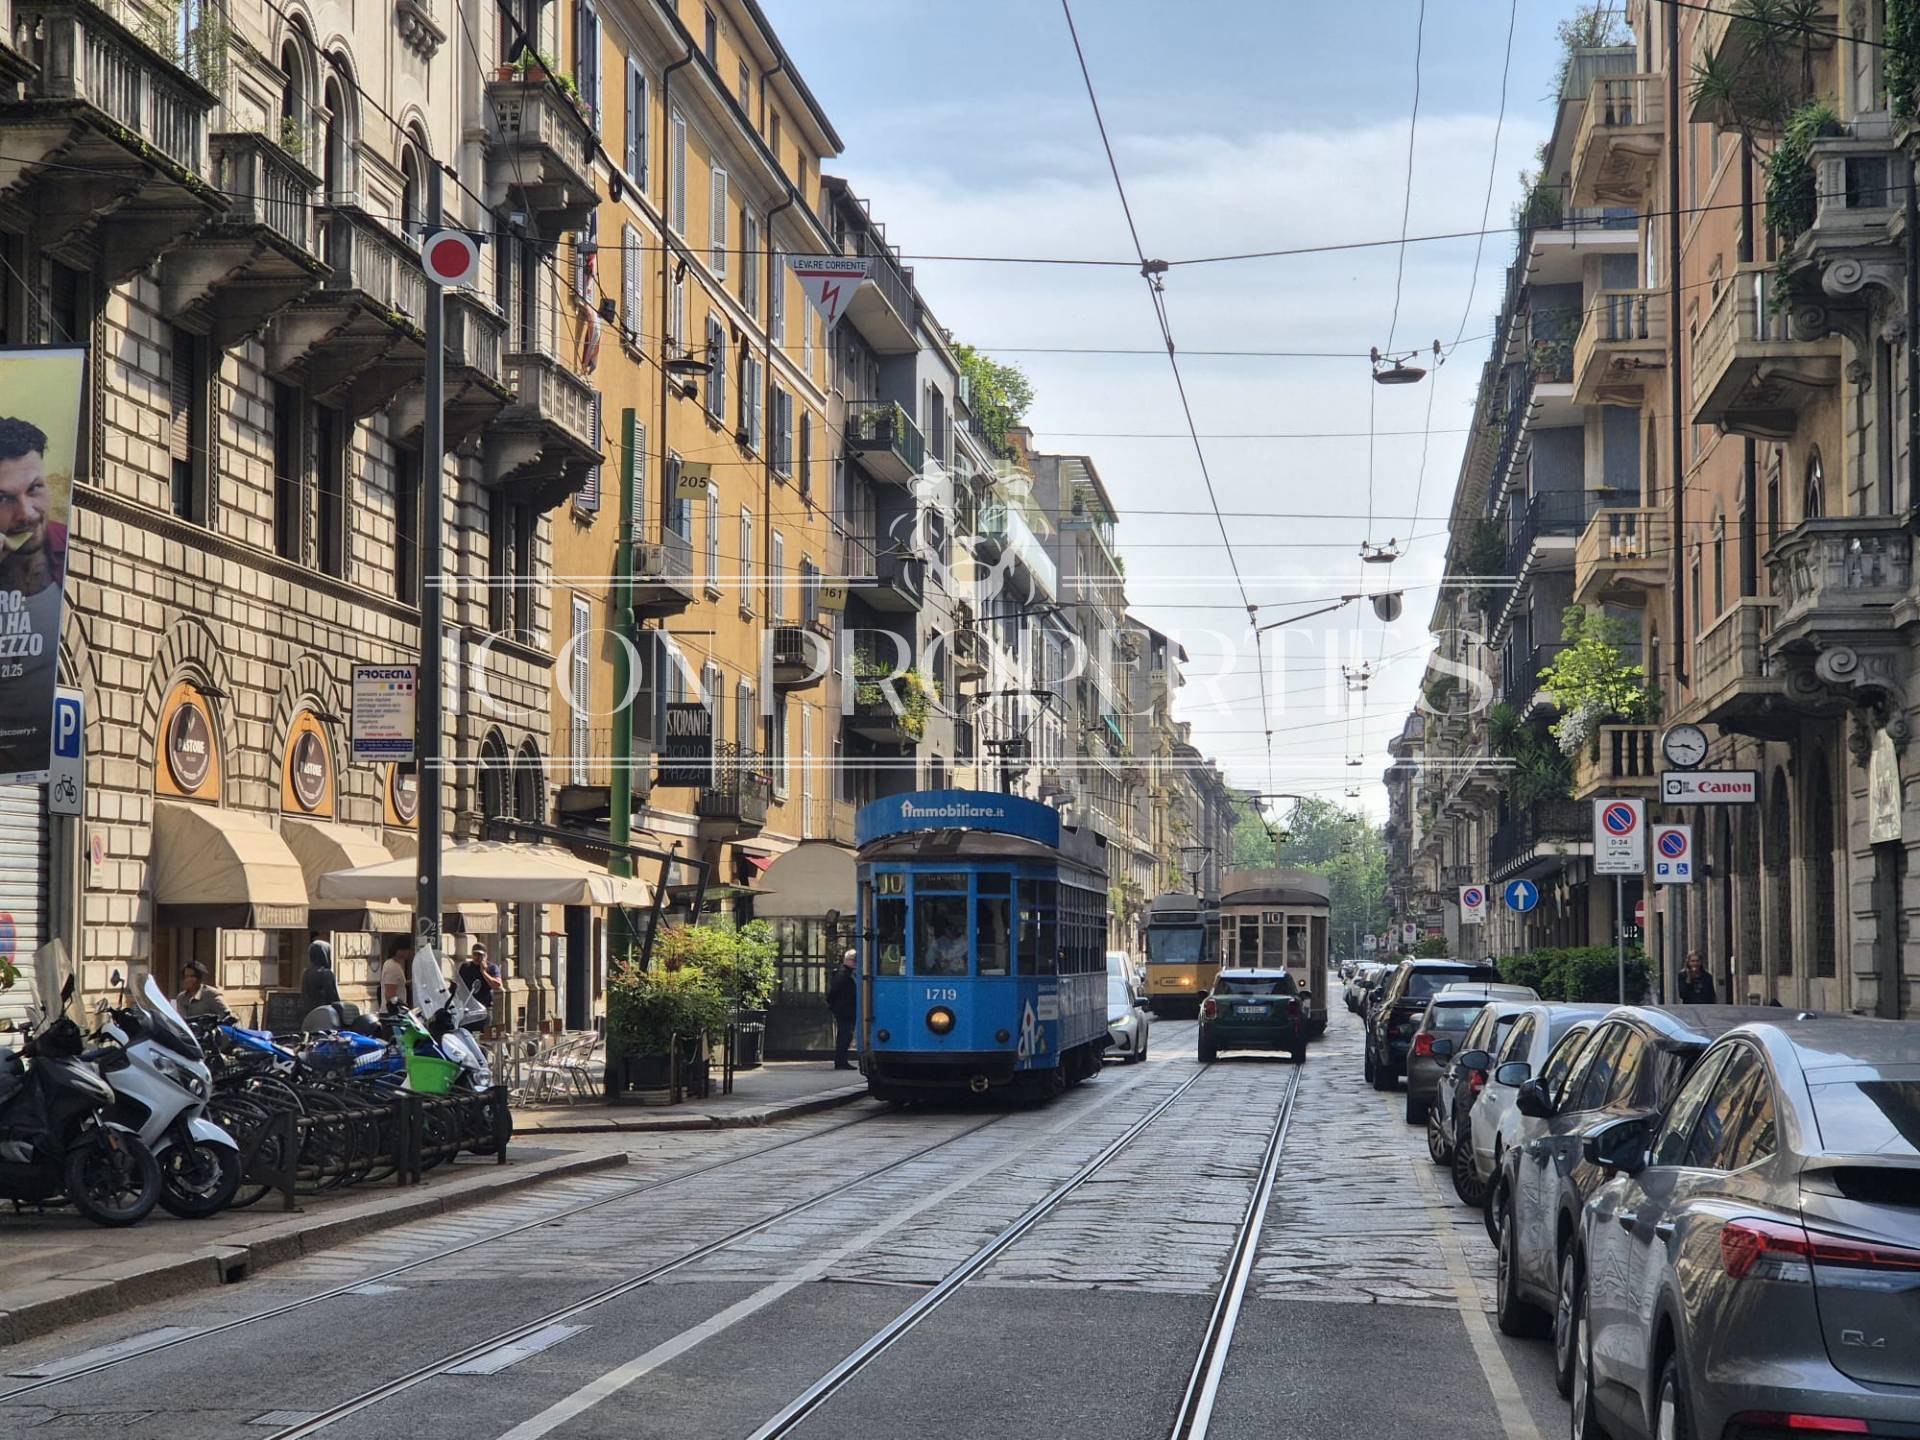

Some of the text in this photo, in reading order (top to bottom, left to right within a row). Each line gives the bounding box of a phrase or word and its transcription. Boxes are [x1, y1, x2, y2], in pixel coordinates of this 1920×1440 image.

[794, 259, 867, 270] LEVARE CORRENTE
[679, 476, 708, 489] 205
[824, 588, 842, 599] 161
[6, 611, 32, 635] HA
[357, 670, 412, 679] PROTECNA
[58, 704, 76, 751] P
[1698, 781, 1752, 793] Canon
[901, 799, 1005, 818] immobiliare.it
[1659, 864, 1667, 874] P
[1266, 912, 1281, 924] 10
[926, 988, 957, 1000] 1719
[1841, 1328, 1886, 1348] Q4
